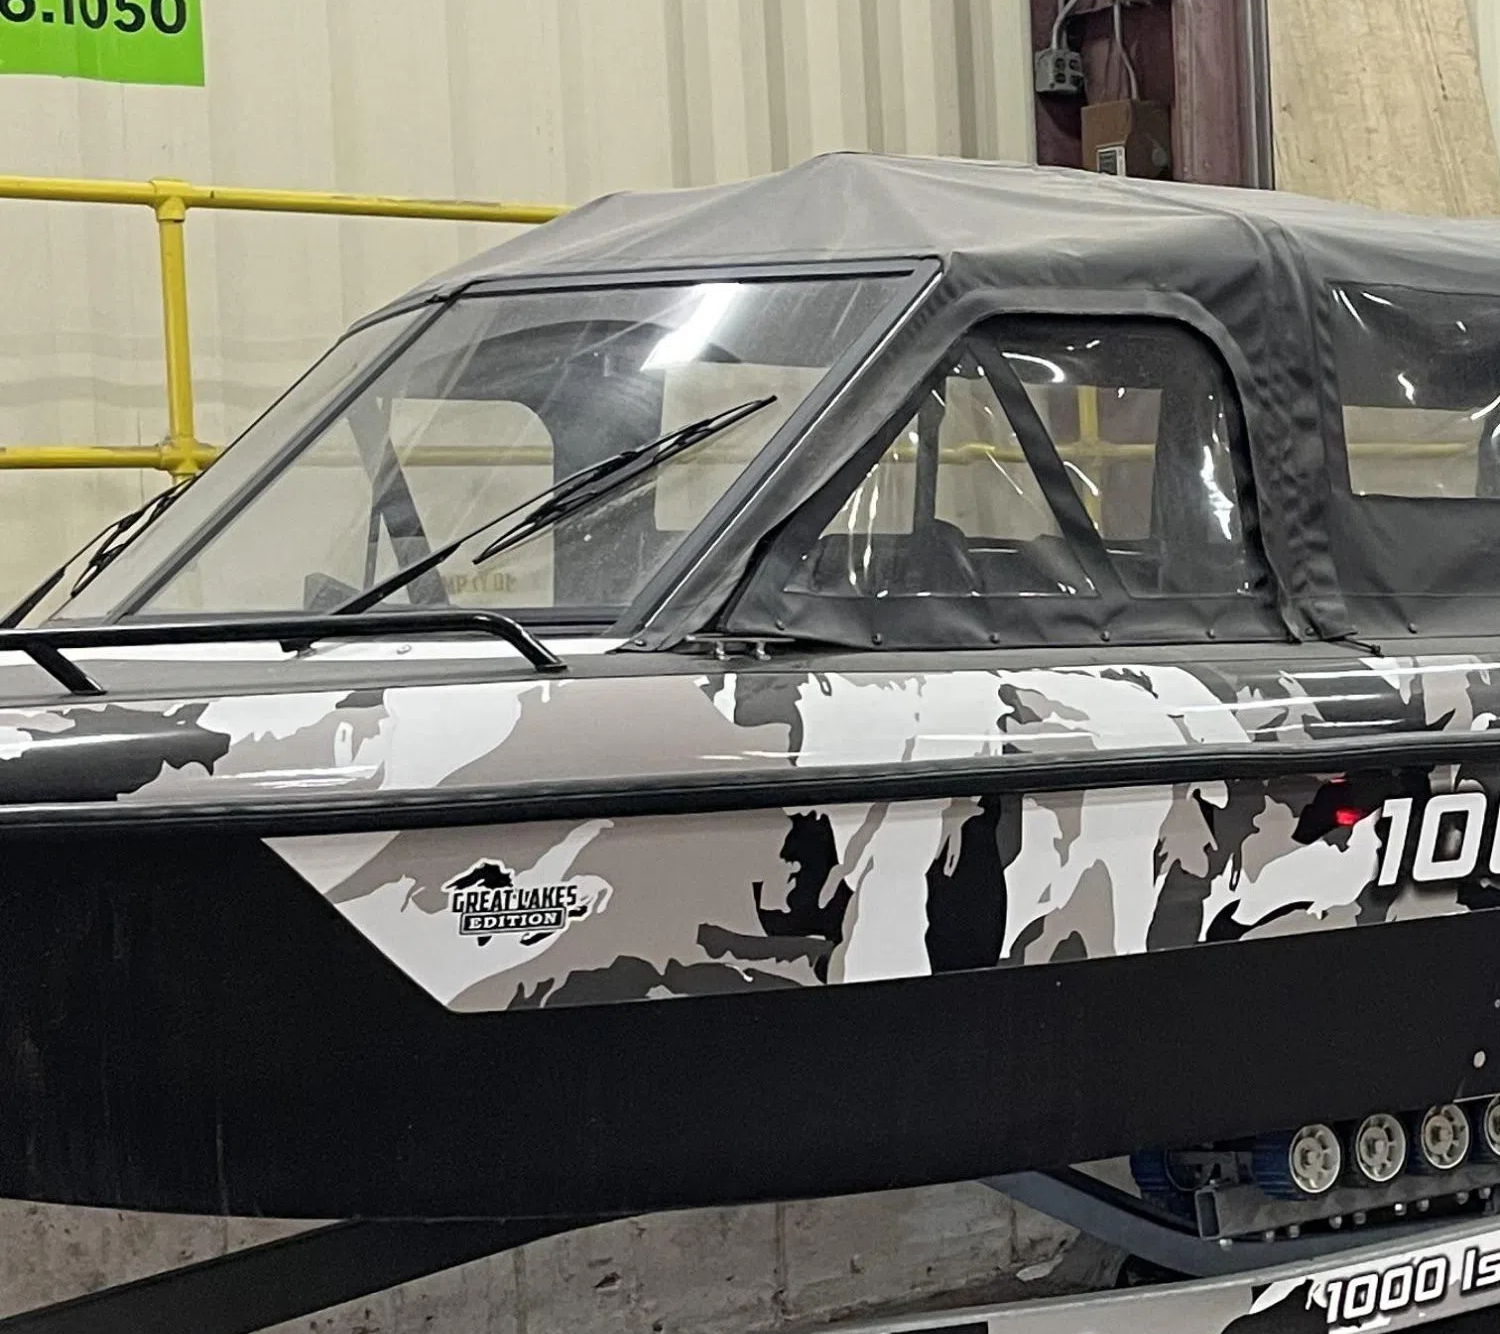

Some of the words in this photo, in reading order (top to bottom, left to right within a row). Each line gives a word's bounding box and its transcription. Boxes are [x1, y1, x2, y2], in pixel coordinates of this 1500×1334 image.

[452, 889, 514, 914] GREAT
[517, 884, 577, 910] LAKES
[468, 912, 557, 930] EDITION
[1325, 1257, 1447, 1324] 1000
